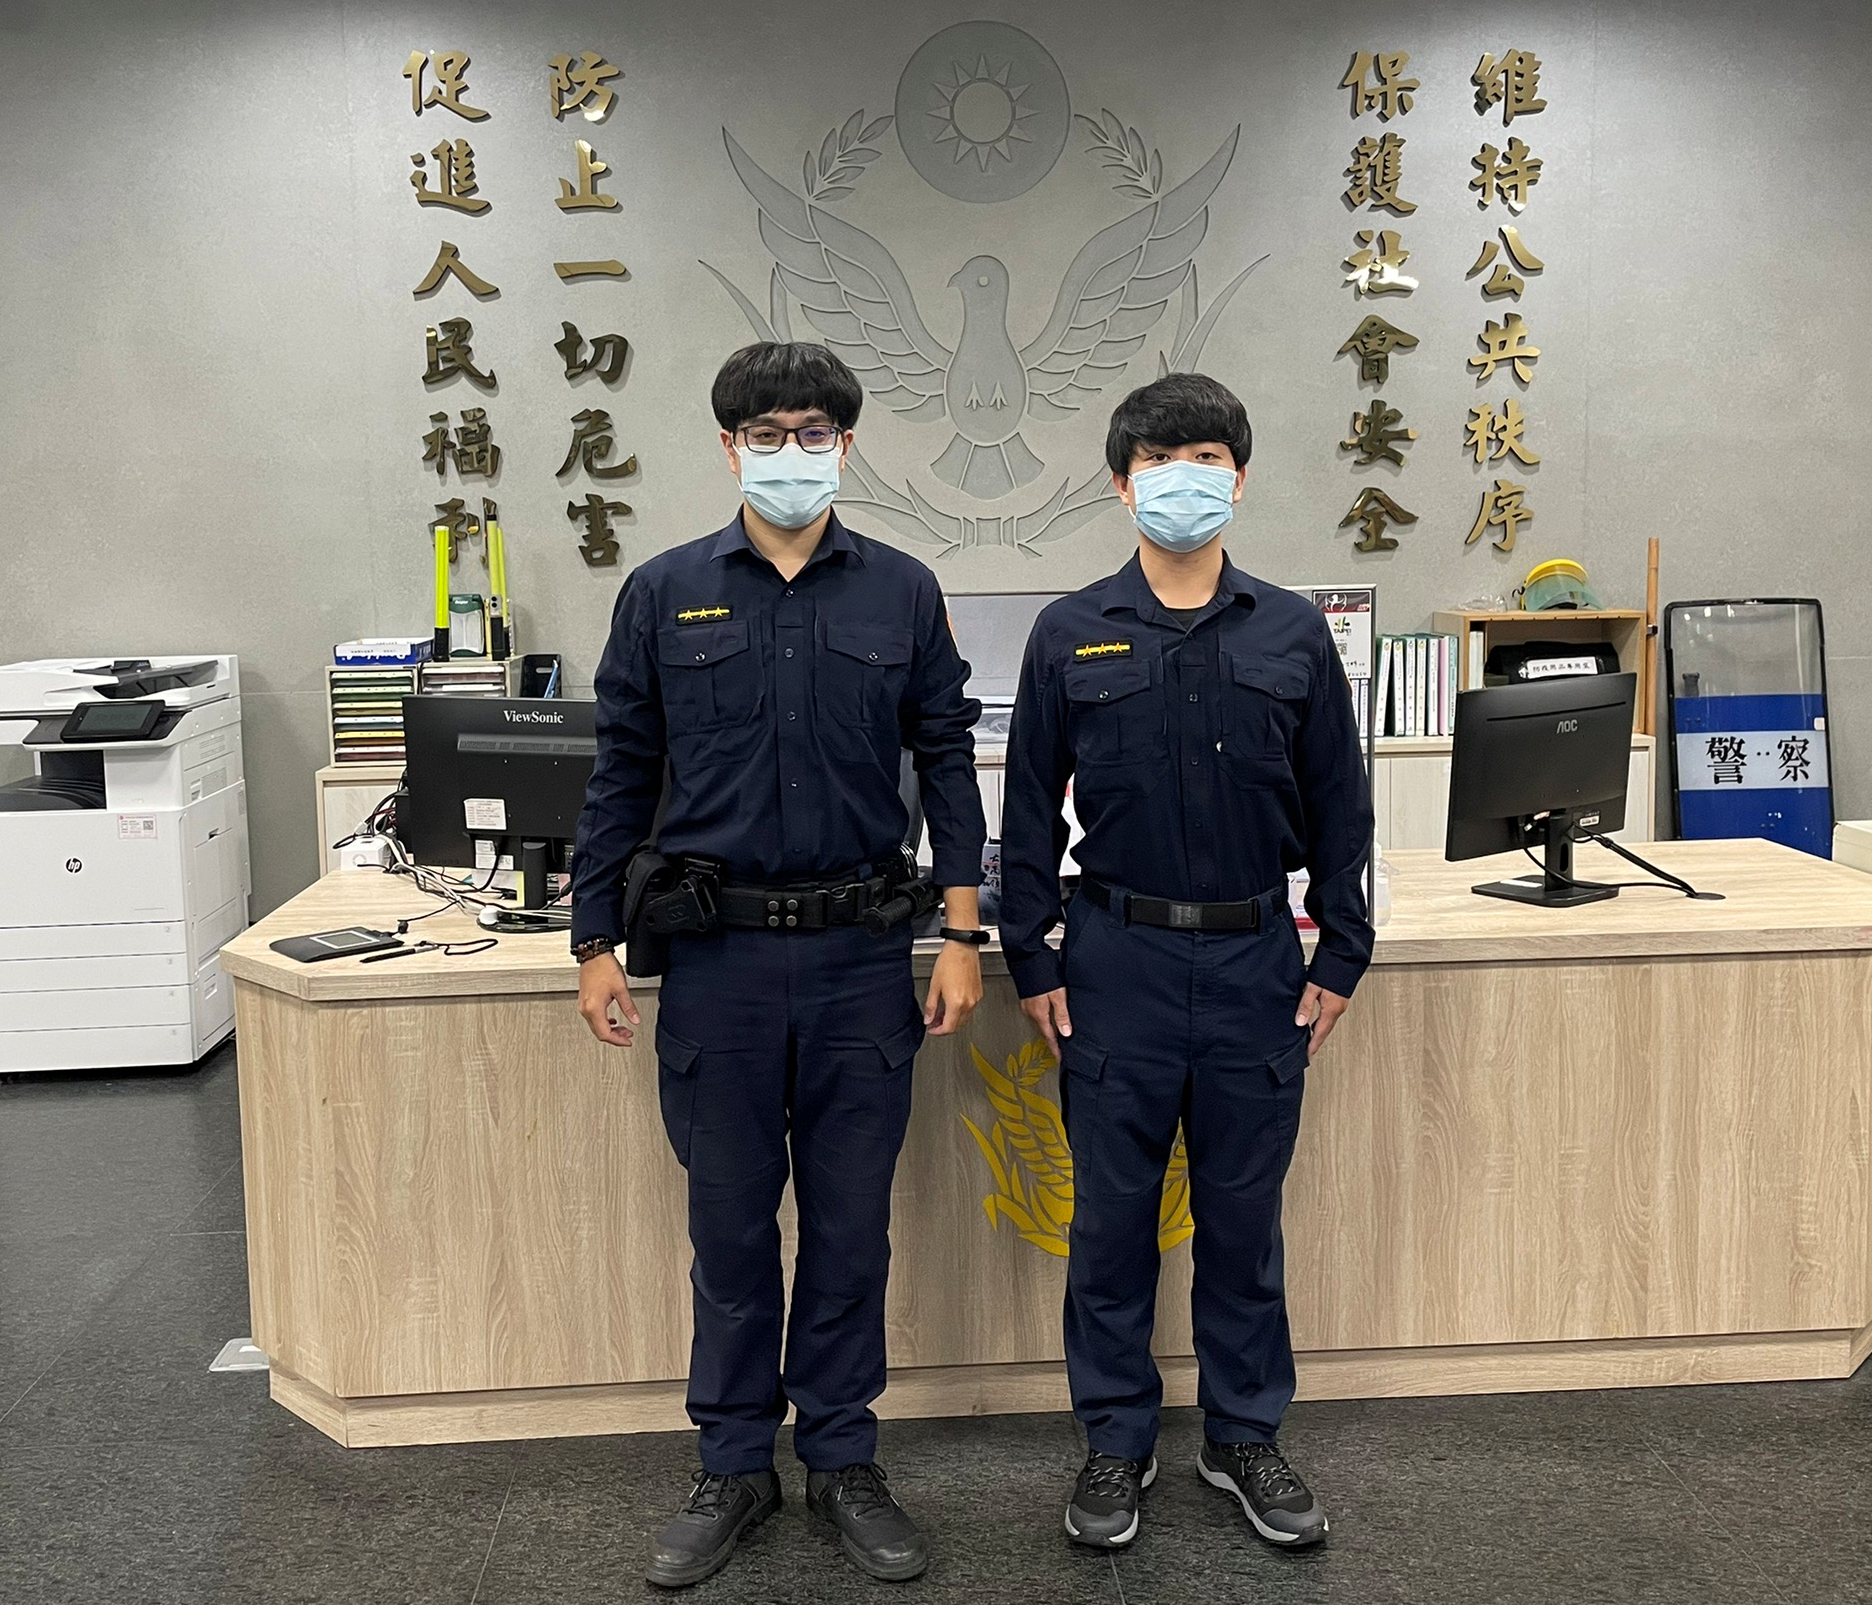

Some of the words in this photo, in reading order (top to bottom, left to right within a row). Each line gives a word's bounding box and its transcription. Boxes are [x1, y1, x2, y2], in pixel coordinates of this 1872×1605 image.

[549, 50, 636, 567] 防止一切危害
[1338, 49, 1420, 551] 保護社會安全
[1464, 48, 1547, 552] 維持公共秩序
[503, 710, 564, 724] ViewSonic
[1556, 719, 1578, 734] AOC
[1705, 735, 1811, 784] 警察
[66, 858, 82, 873] hp
